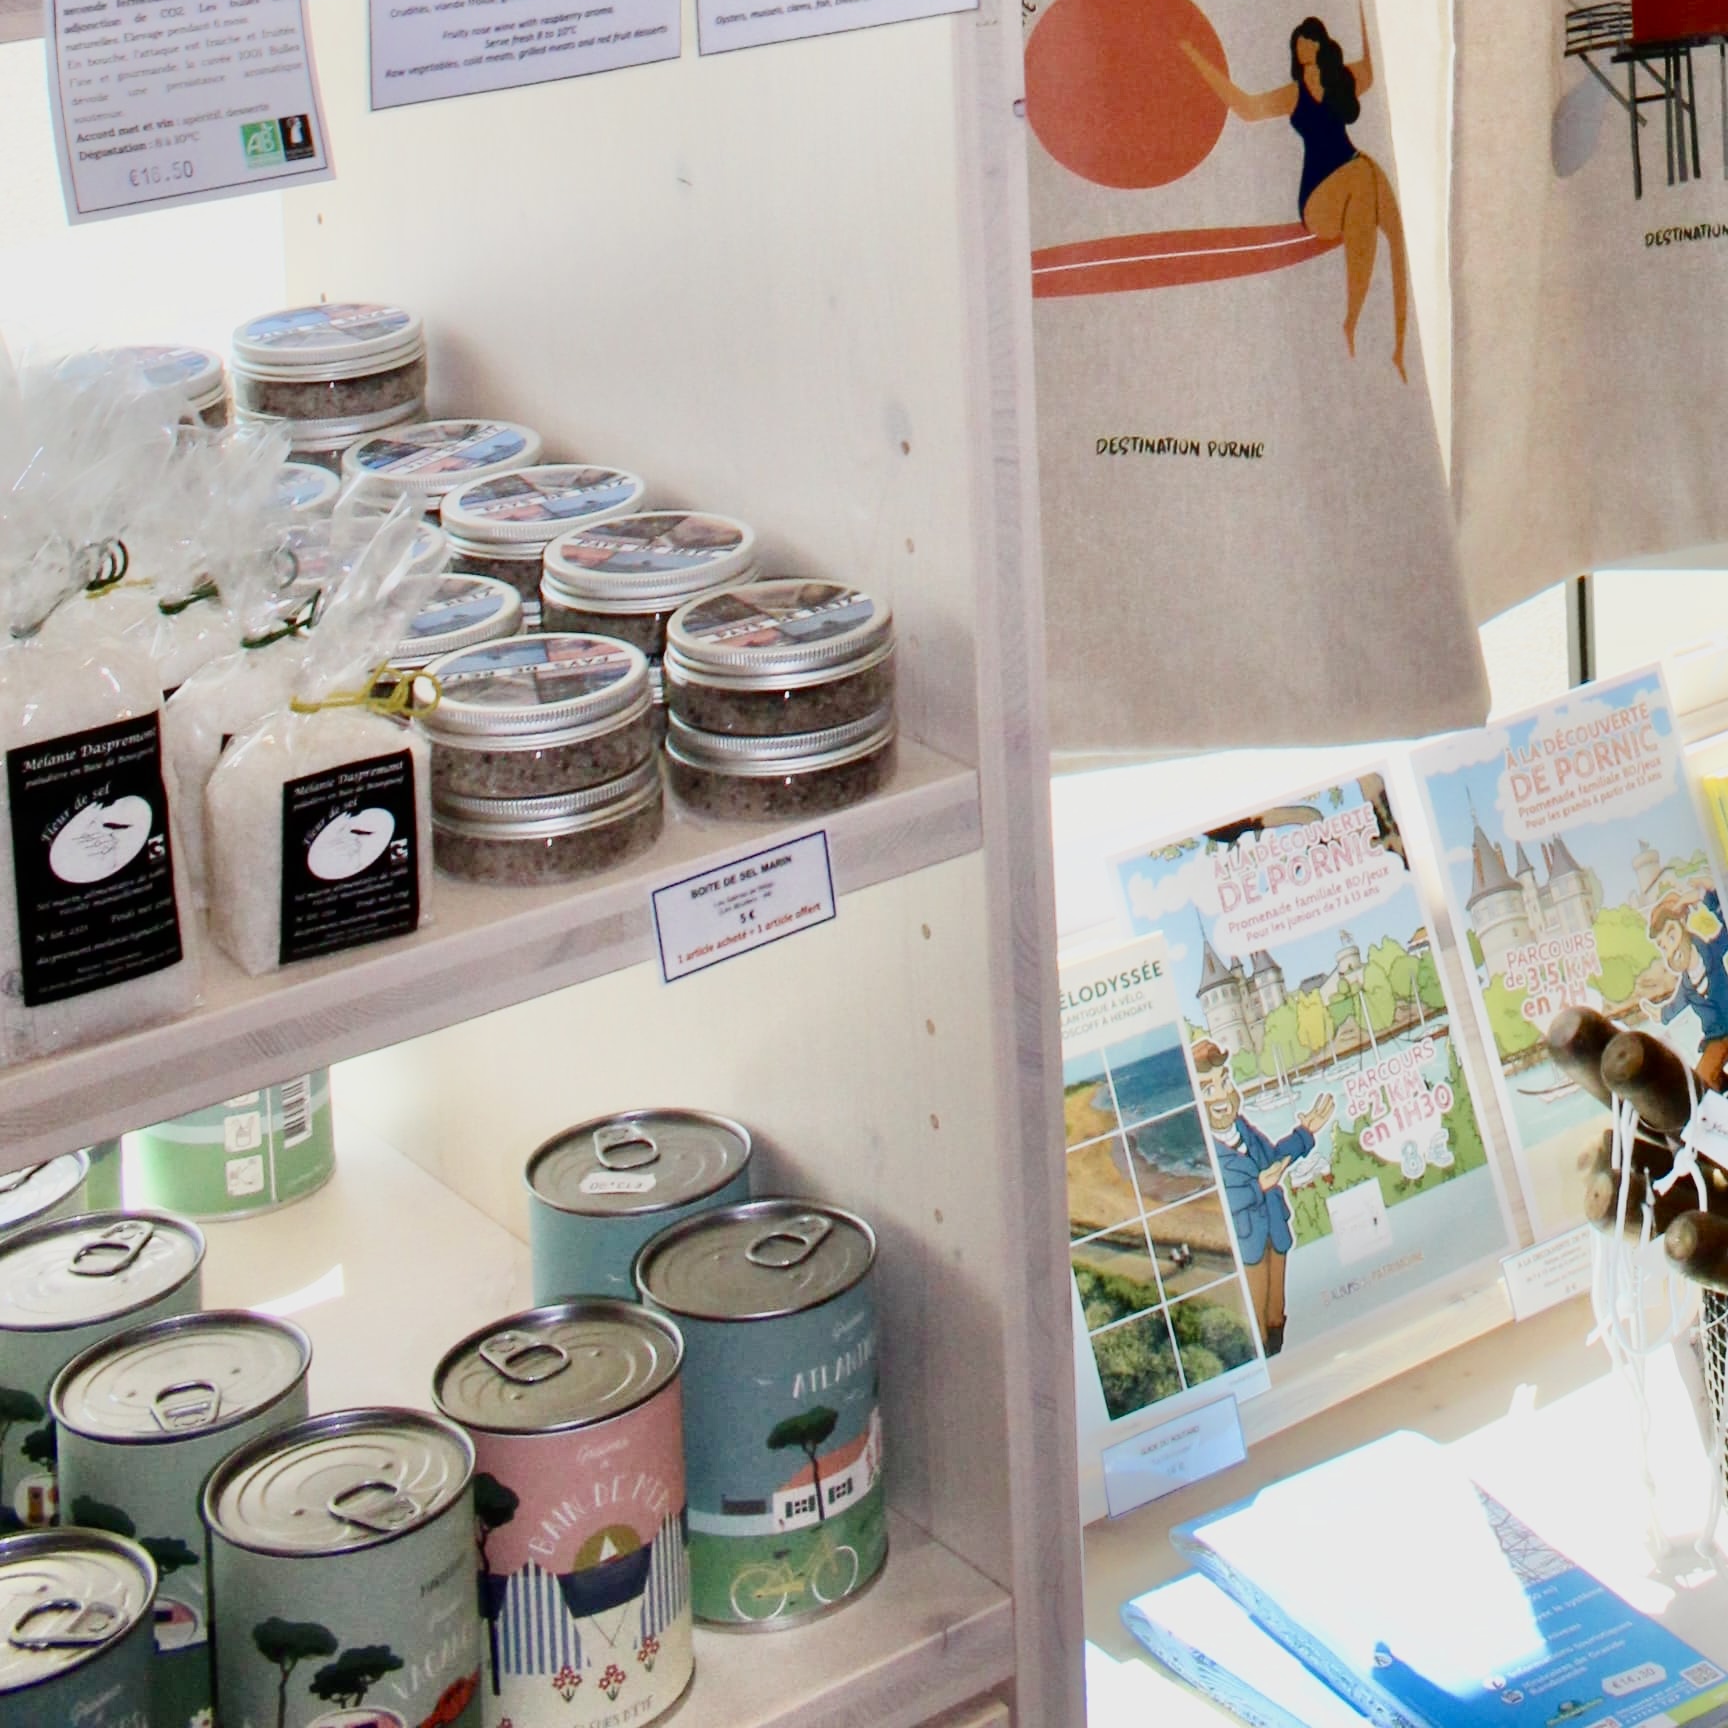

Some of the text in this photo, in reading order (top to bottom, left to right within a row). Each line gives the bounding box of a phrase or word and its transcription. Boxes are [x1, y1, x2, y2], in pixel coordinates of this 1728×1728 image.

[1095, 436, 1266, 460] DESTINATION PORNIC
[21, 726, 156, 774] Mélanie Daspremont
[1503, 702, 1648, 769] À LA DÉCOUVERTE
[1509, 725, 1657, 802] DE PORNIC
[92, 782, 112, 803] sel
[1517, 788, 1575, 818] Promenade
[1577, 771, 1620, 794] familiale
[1209, 805, 1373, 878] À LA DÉCOUVERTE
[690, 880, 720, 899] BOITE
[722, 874, 736, 887] DE
[739, 866, 757, 881] SEL
[761, 854, 791, 873] MARIN
[1216, 829, 1382, 913] DE PORNIC
[739, 909, 755, 923] 5 €
[1227, 900, 1292, 933] Promenade
[1294, 880, 1342, 907] familiale
[677, 954, 682, 964] 1
[685, 942, 713, 961] article
[716, 930, 746, 949] acheté
[757, 924, 762, 934] 1
[765, 912, 792, 931] article
[795, 900, 820, 919] offert
[1507, 928, 1593, 972] PARCOURS
[1504, 970, 1526, 992] de
[1562, 947, 1599, 980] KM
[1522, 994, 1551, 1020] en
[1343, 1041, 1436, 1094] PARCOURS
[1347, 1069, 1425, 1118] de 2 KM
[1359, 1082, 1455, 1149] en 1H30
[1396, 1128, 1455, 1180] 8 €
